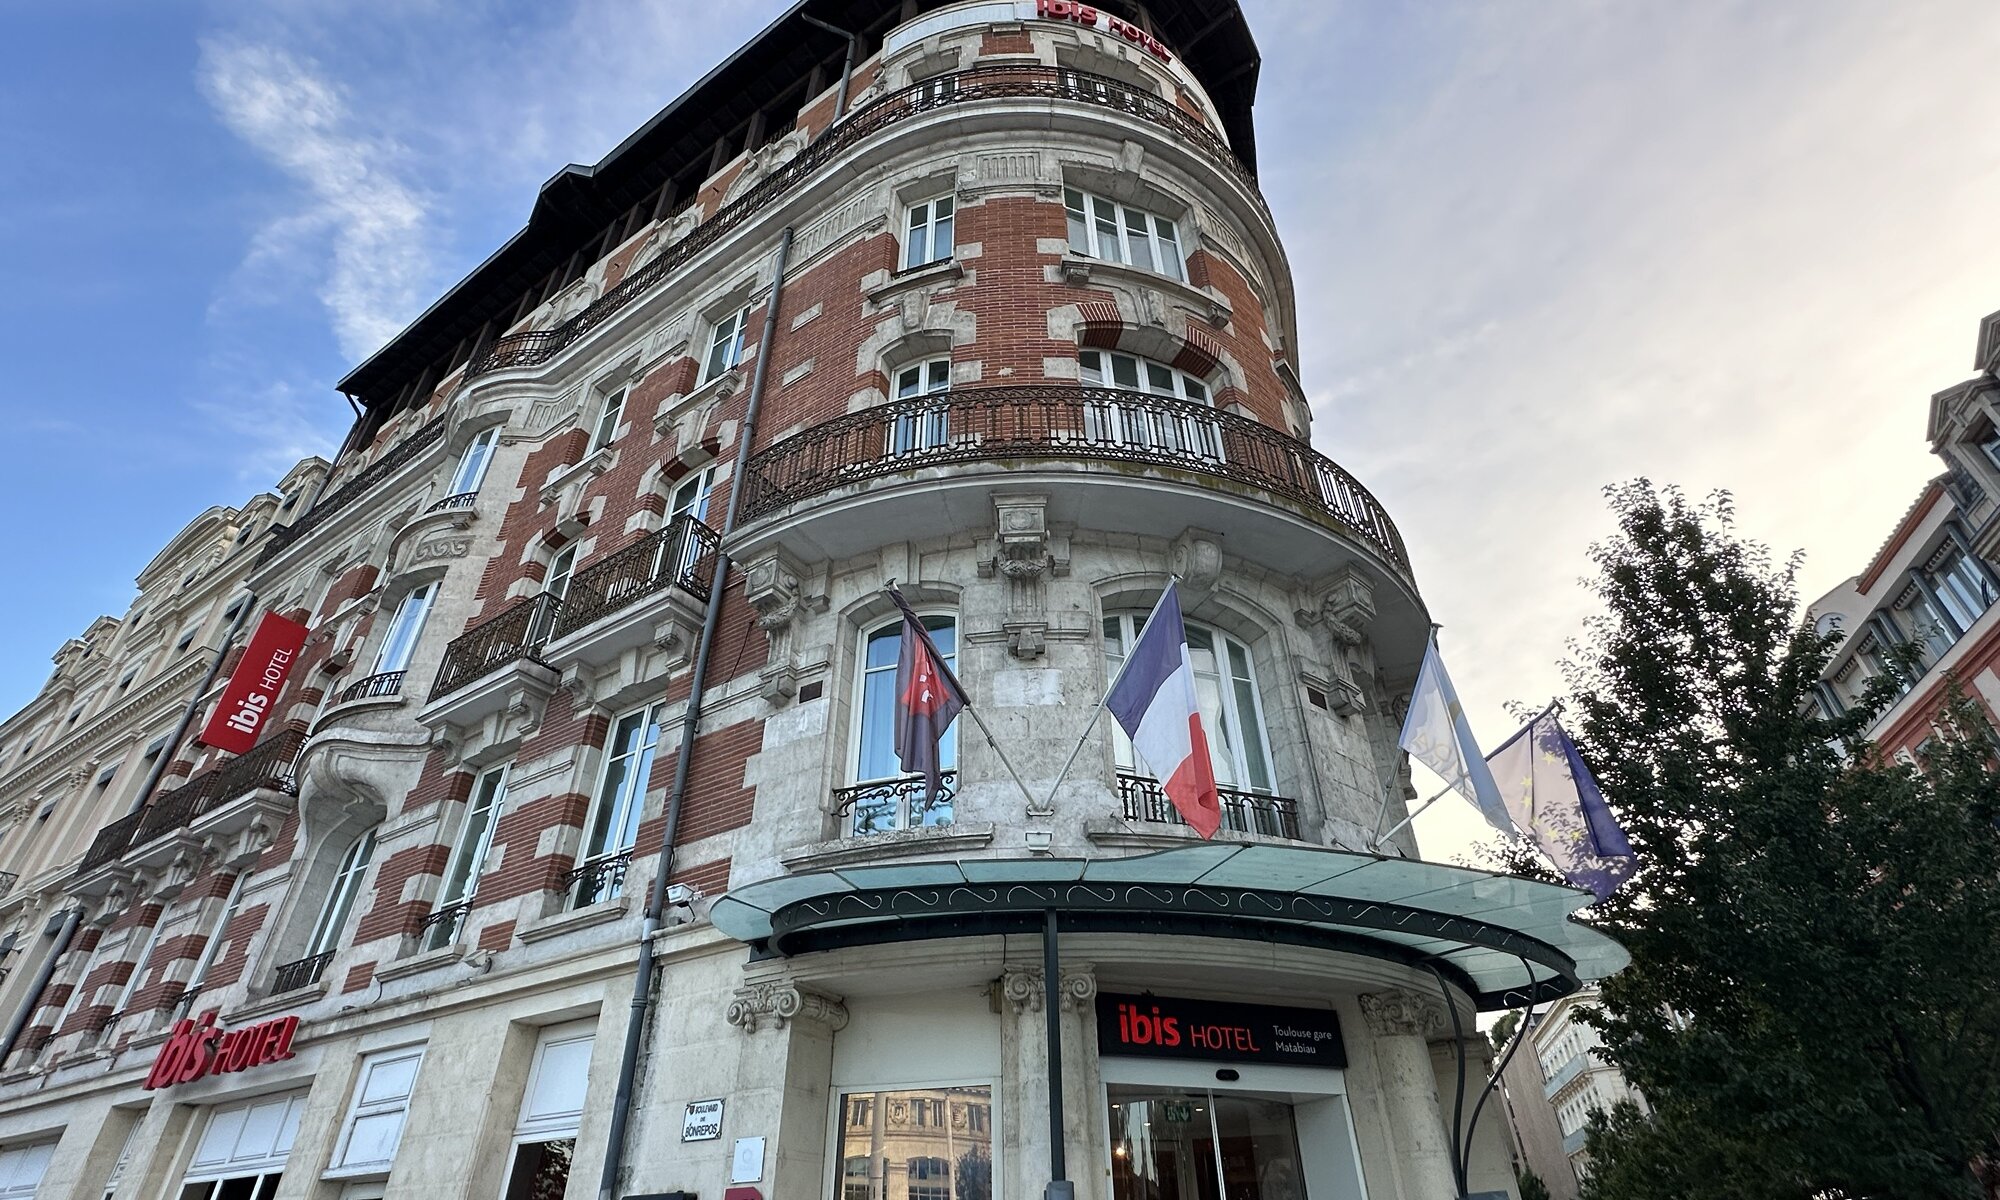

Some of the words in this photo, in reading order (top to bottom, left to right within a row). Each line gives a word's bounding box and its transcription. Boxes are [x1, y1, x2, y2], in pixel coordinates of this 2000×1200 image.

[1109, 16, 1172, 64] HOTEL
[227, 692, 268, 734] ibis
[259, 648, 293, 691] HOTEL
[143, 1011, 224, 1090] ibis
[210, 1016, 300, 1075] HOTEL
[1119, 1003, 1181, 1047] ibis
[1191, 1025, 1260, 1052] HOTEL
[1272, 1024, 1312, 1039] Toulouse
[1313, 1031, 1332, 1042] gare
[1275, 1040, 1316, 1054] Matabiau
